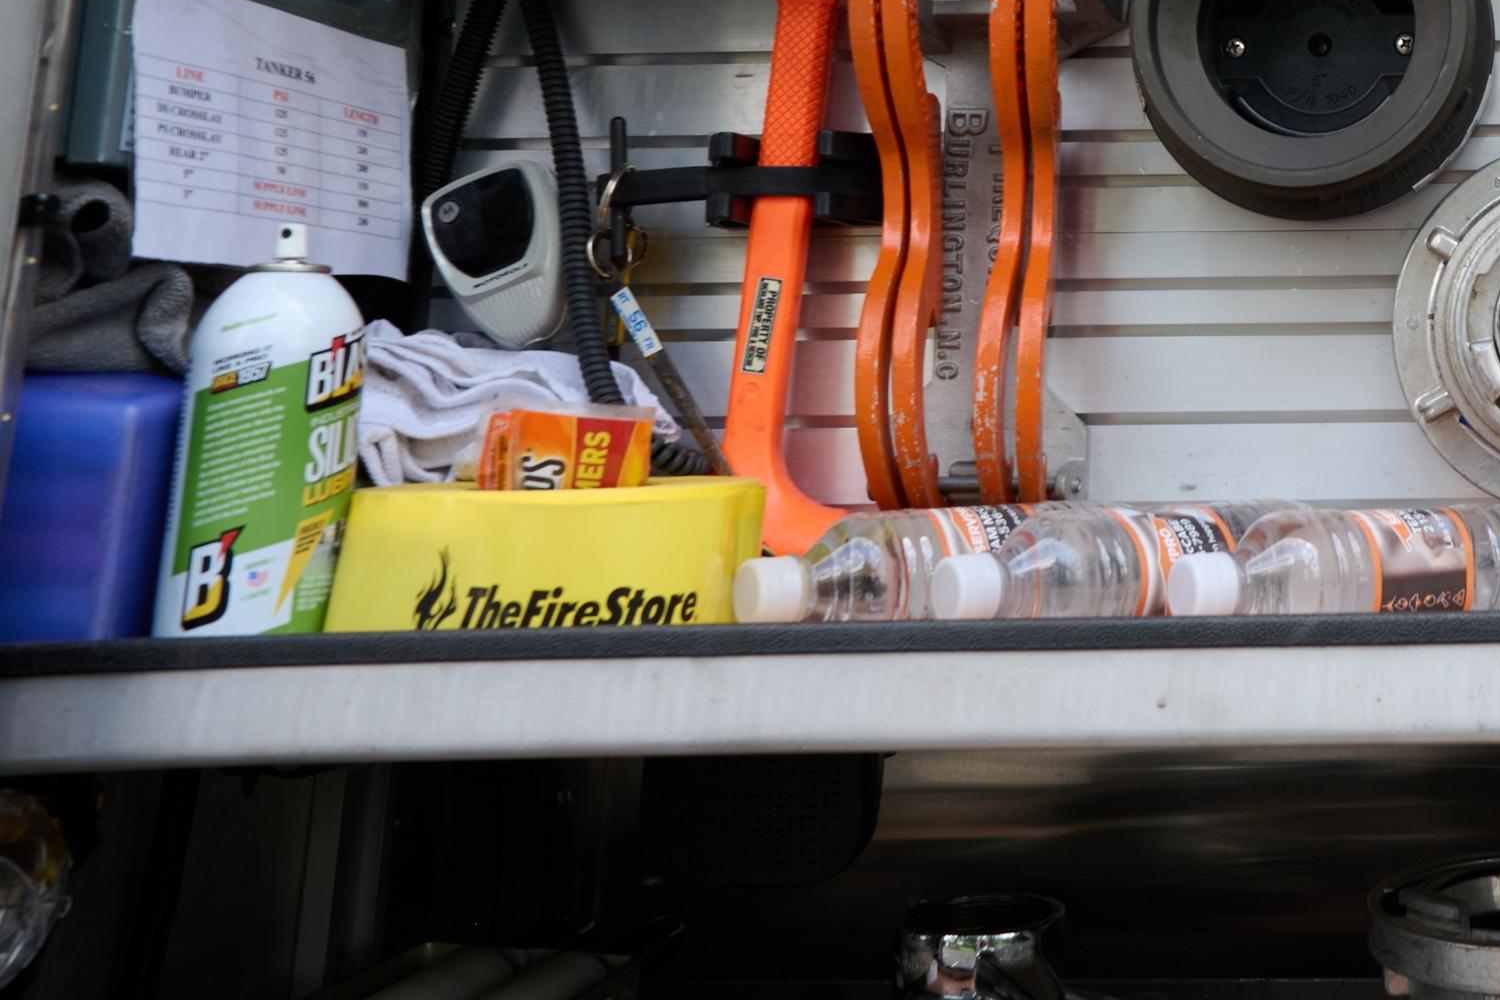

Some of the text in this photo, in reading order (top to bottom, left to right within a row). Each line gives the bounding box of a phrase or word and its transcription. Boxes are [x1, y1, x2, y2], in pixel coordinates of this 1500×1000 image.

[176, 66, 205, 83] LINE
[255, 57, 301, 81] TANKER
[168, 85, 212, 101] BUMPER
[758, 290, 778, 347] PROPERTY
[460, 583, 698, 629] TheFireStore
